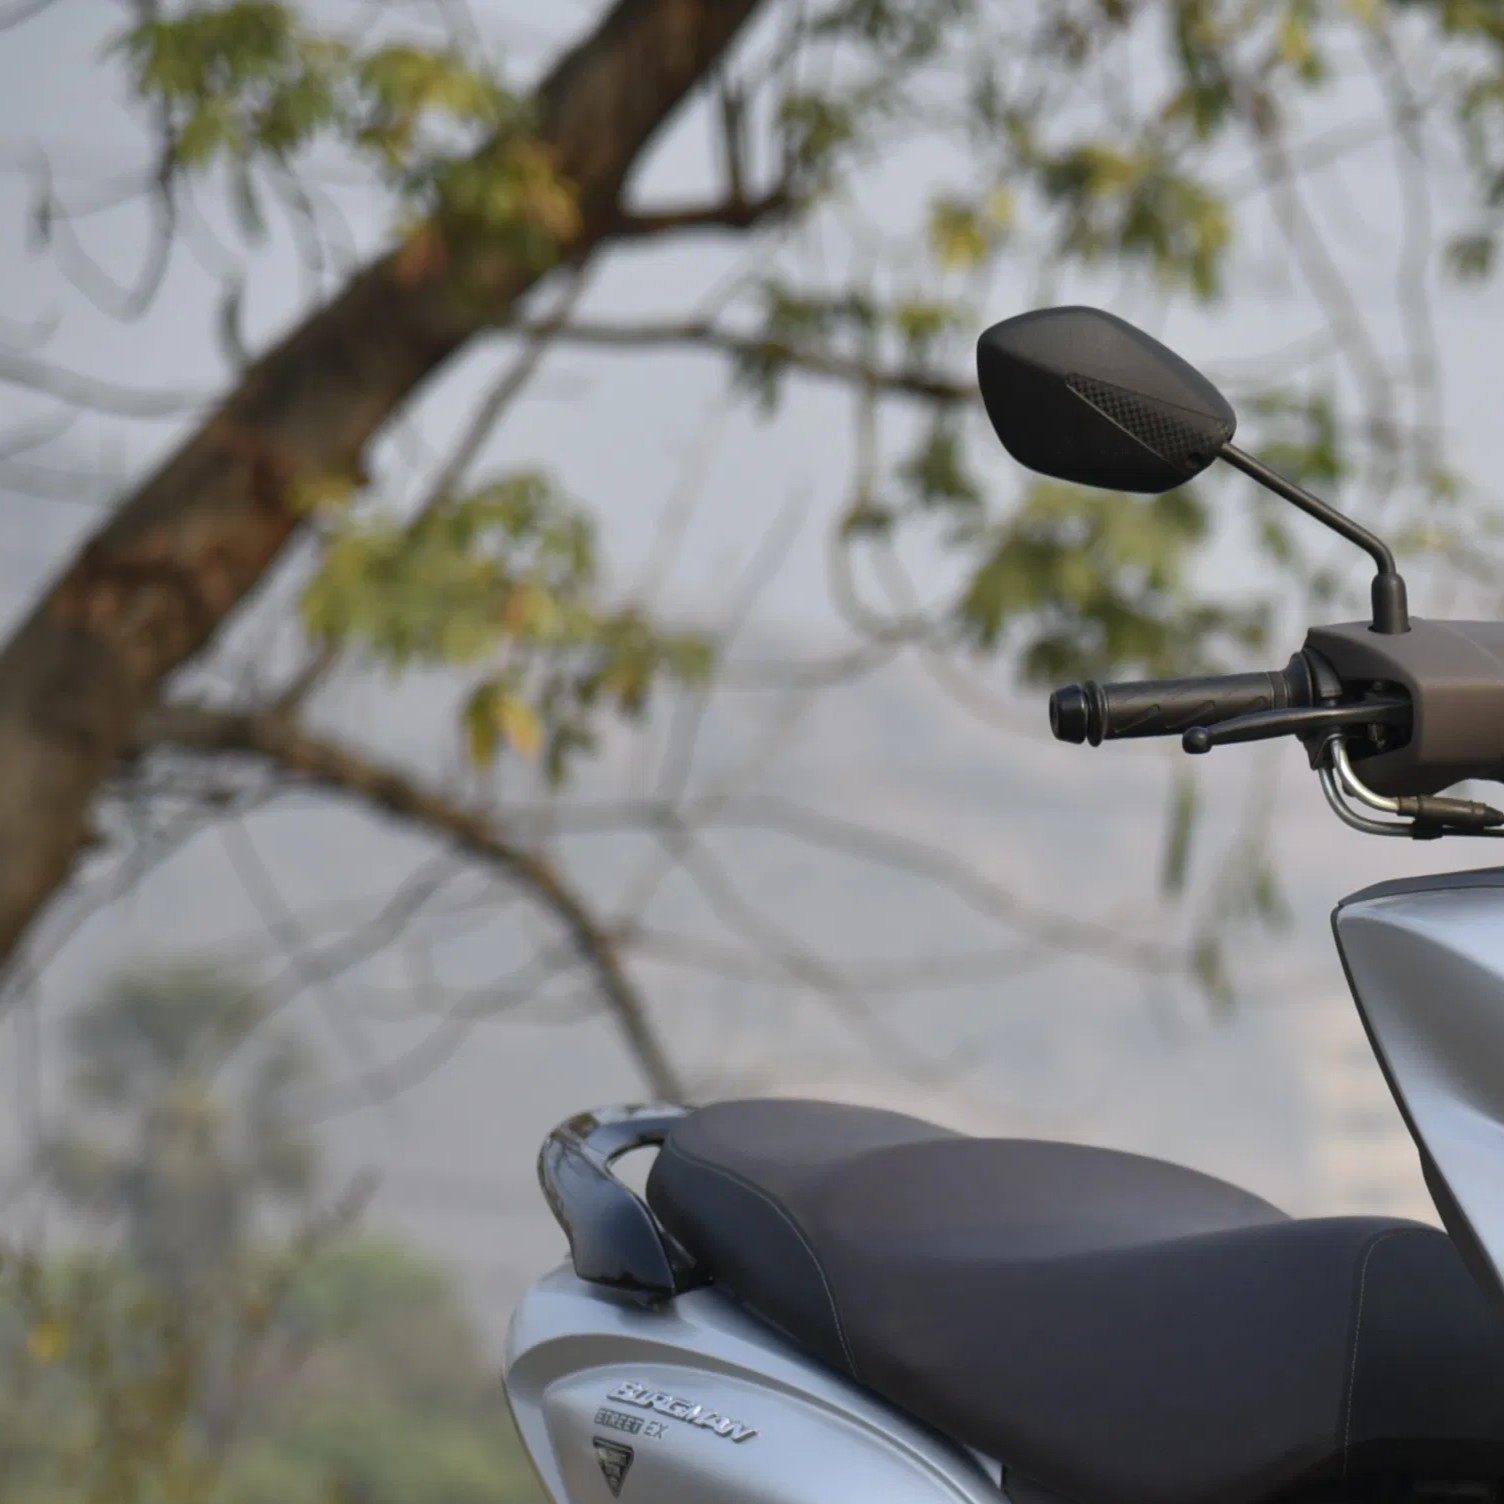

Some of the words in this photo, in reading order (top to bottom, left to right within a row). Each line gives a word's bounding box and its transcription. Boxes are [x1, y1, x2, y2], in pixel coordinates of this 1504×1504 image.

[594, 1408, 645, 1435] STREET
[643, 1421, 668, 1439] EX
[607, 1382, 758, 1443] BURGMAN
